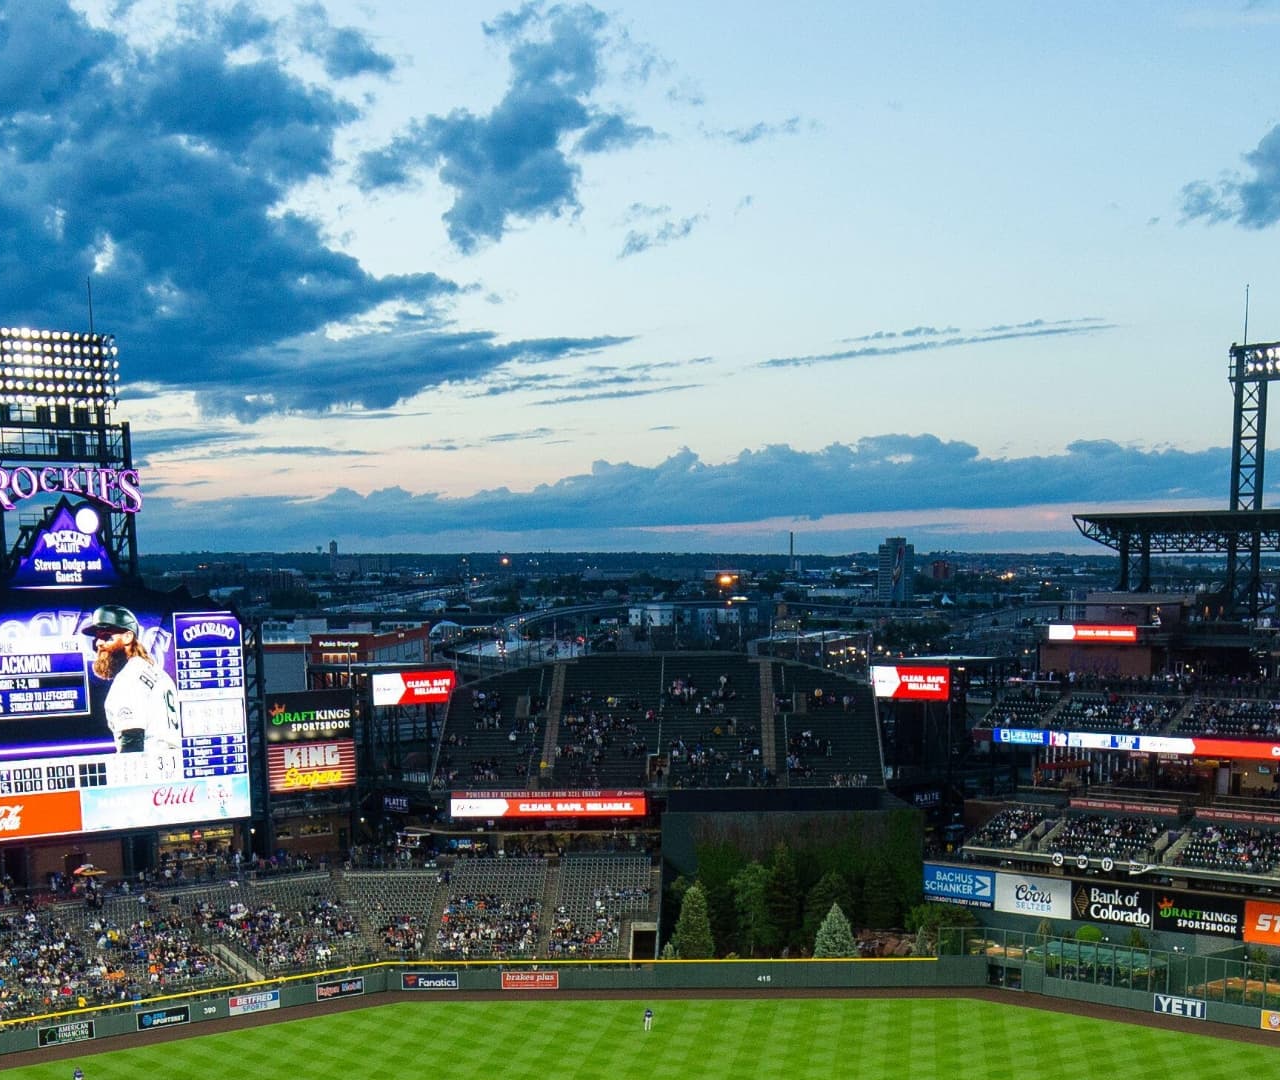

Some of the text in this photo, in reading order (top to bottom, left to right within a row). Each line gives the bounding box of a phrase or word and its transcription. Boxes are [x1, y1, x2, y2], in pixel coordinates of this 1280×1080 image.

[42, 530, 91, 548] ROCKIES
[34, 559, 102, 573] Steven Dodge and
[55, 571, 82, 582] Guests
[182, 622, 235, 643] COLORADO
[272, 708, 351, 727] DRAFTKINGS
[291, 719, 350, 732] SPORTSBOOK
[284, 745, 340, 768] KING
[283, 768, 342, 788] Soopers
[152, 786, 196, 807] Chill
[1053, 856, 1063, 864] 42
[935, 870, 974, 885] BACHUS
[924, 879, 973, 895] SCHANKER
[1015, 883, 1052, 904] Coors
[1090, 887, 1140, 907] Bank of
[1016, 901, 1052, 912] SELTZER
[1159, 905, 1238, 924] DRAFTKINGS
[1090, 904, 1151, 926] Colorado
[1176, 918, 1237, 934] SPORTSBOOK
[418, 977, 457, 988] Fanatics
[505, 973, 555, 983] brakes plus
[237, 993, 273, 1005] BETFRED
[241, 1002, 269, 1012] SPORTS
[1159, 997, 1202, 1018] YETI
[58, 1022, 89, 1032] AMERICAN
[58, 1029, 89, 1039] FINANCING
